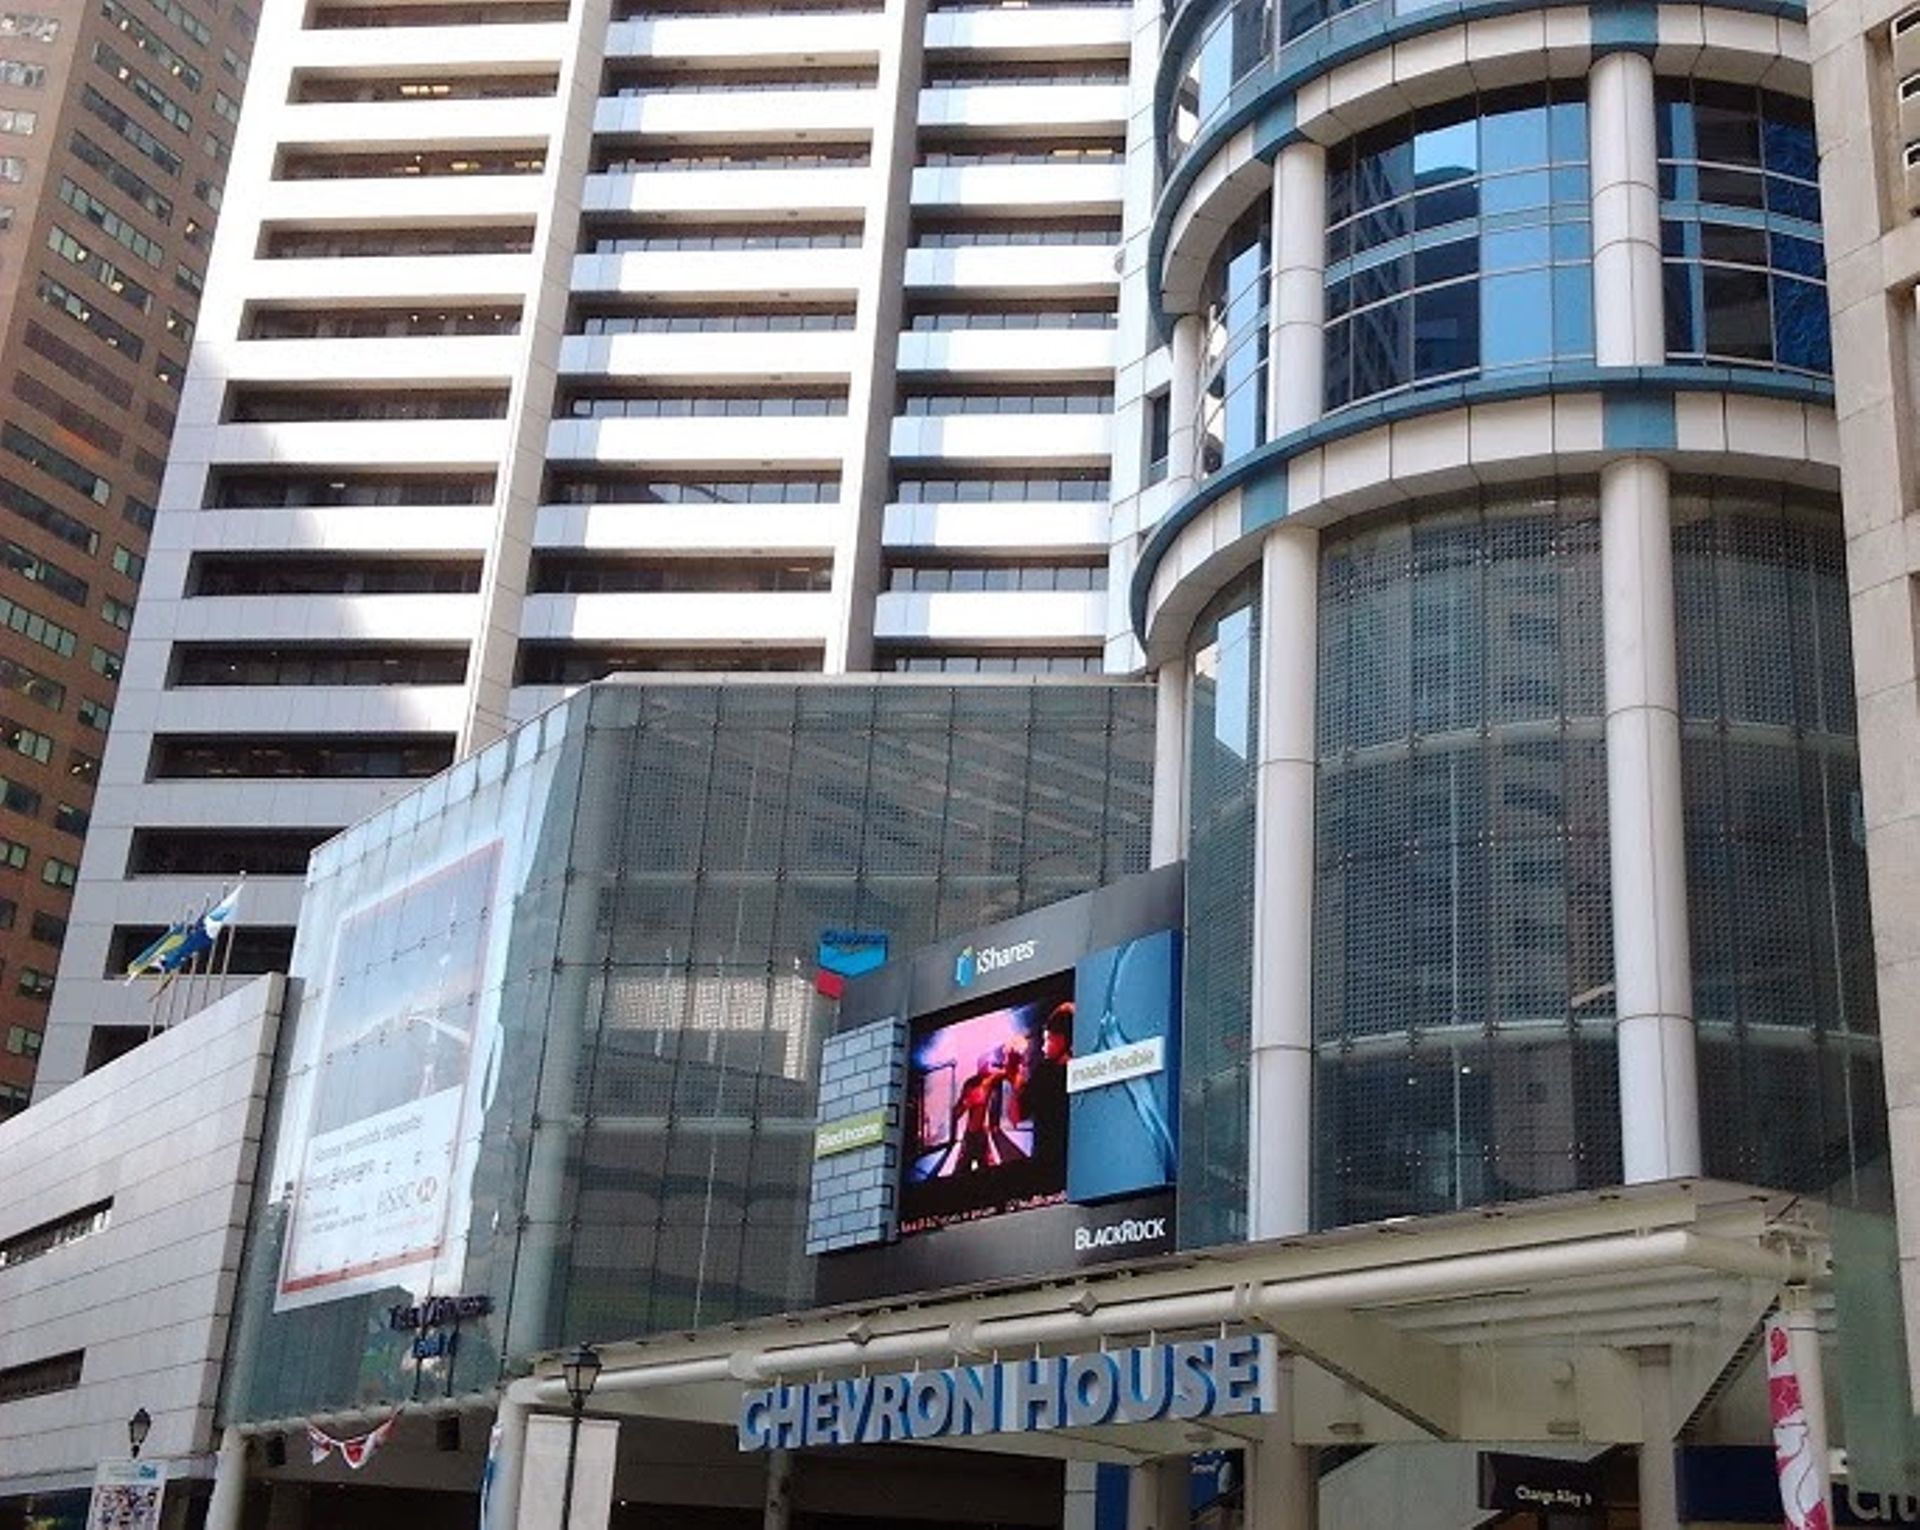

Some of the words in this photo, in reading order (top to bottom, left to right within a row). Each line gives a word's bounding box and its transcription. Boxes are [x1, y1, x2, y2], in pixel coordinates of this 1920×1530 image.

[976, 940, 1035, 976] iShares
[738, 1364, 1001, 1450] CHEVRON
[1016, 1335, 1262, 1431] HOUSE
